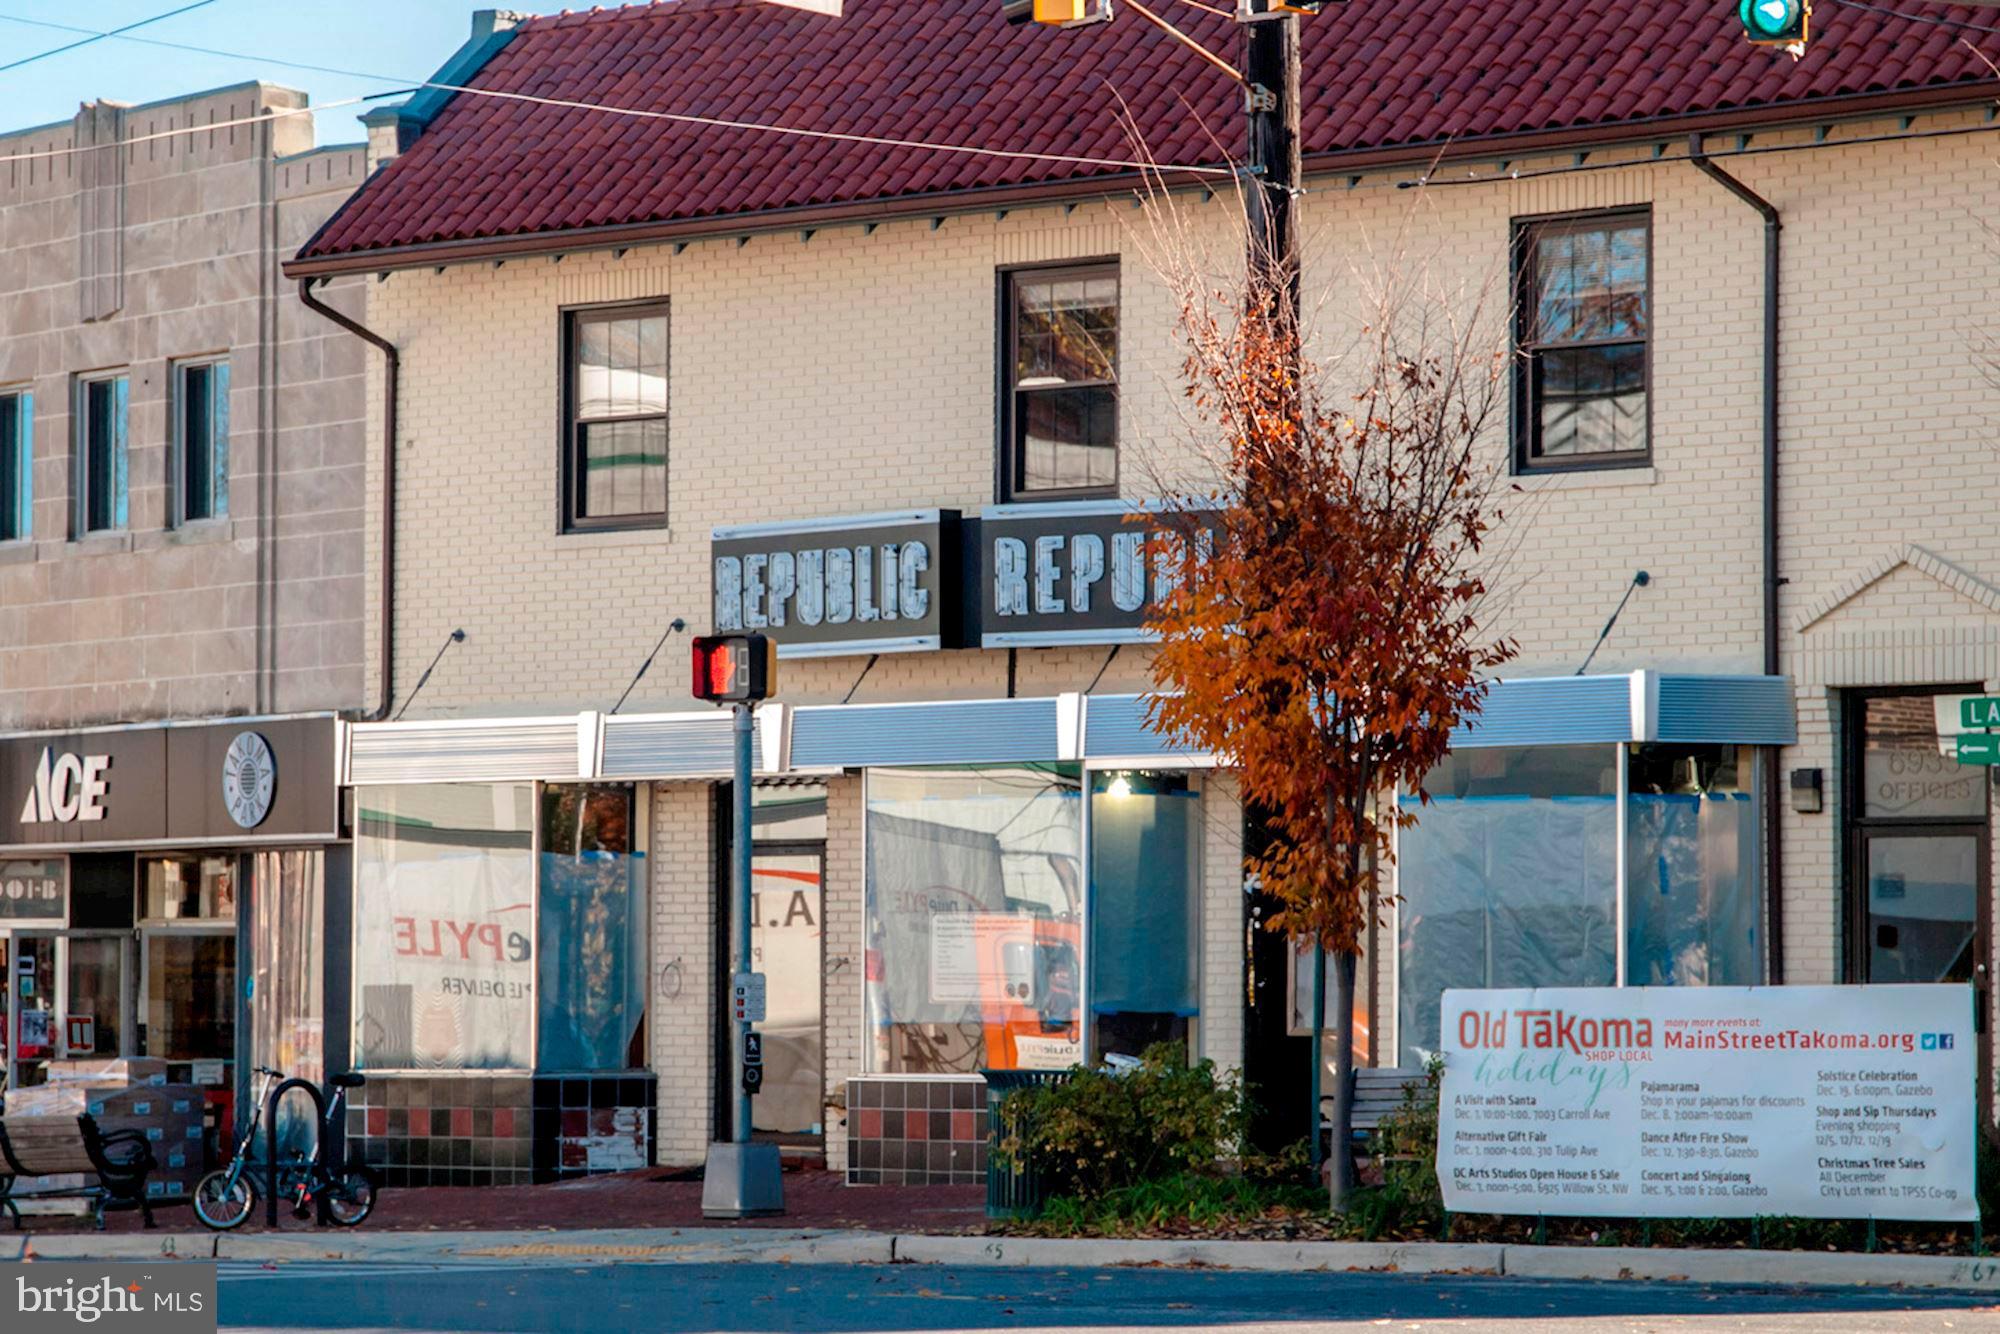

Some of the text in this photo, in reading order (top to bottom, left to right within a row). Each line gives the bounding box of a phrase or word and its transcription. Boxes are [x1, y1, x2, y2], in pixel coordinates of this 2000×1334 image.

[715, 541, 928, 629] REPUBLIC
[226, 735, 270, 781] TAKOMA
[20, 745, 110, 823] ACE
[1458, 1010, 1507, 1049] Old
[1664, 1018, 1761, 1029] many more events at
[1664, 1030, 1914, 1052] MainStreetTakoma.org
[1585, 1051, 1653, 1062] SHOP LOCAL
[1475, 1050, 1641, 1110] holidays
[1817, 1070, 1918, 1081] Solstice Celebration
[1641, 1080, 1699, 1093] Pajamarama
[1895, 1084, 1933, 1096] Gazebo
[1454, 1095, 1536, 1105] A Visit with Santa
[1641, 1095, 1805, 1108] Shop in your pajamas for discounts
[1558, 1109, 1590, 1119] Carroll
[1593, 1110, 1610, 1119] Ave
[1816, 1106, 1936, 1118] Shop and Sip Thursdays
[1816, 1121, 1900, 1133] Evening shopping
[1454, 1130, 1547, 1141] Alternative Gift Fair
[1641, 1132, 1748, 1143] Dance Afire Fire Show
[1555, 1145, 1577, 1157] Tulip
[1580, 1145, 1598, 1155] Ave
[1724, 1147, 1759, 1158] Gazebo
[1818, 1157, 1926, 1168] Christmas Tree Sales
[1453, 1168, 1466, 1178] DC
[1468, 1168, 1490, 1178] Arts
[1492, 1168, 1527, 1179] Studios
[1529, 1169, 1553, 1181] Open
[1557, 1169, 1588, 1180] House
[1599, 1169, 1619, 1180] Sale
[1641, 1170, 1751, 1183] Concert and Singalong
[1819, 1172, 1886, 1182] All December
[1562, 1183, 1595, 1194] Willow
[1612, 1184, 1629, 1194] NW
[1732, 1185, 1768, 1196] Gazebo
[1820, 1185, 1958, 1200] City Lot next to TPSS Co-op
